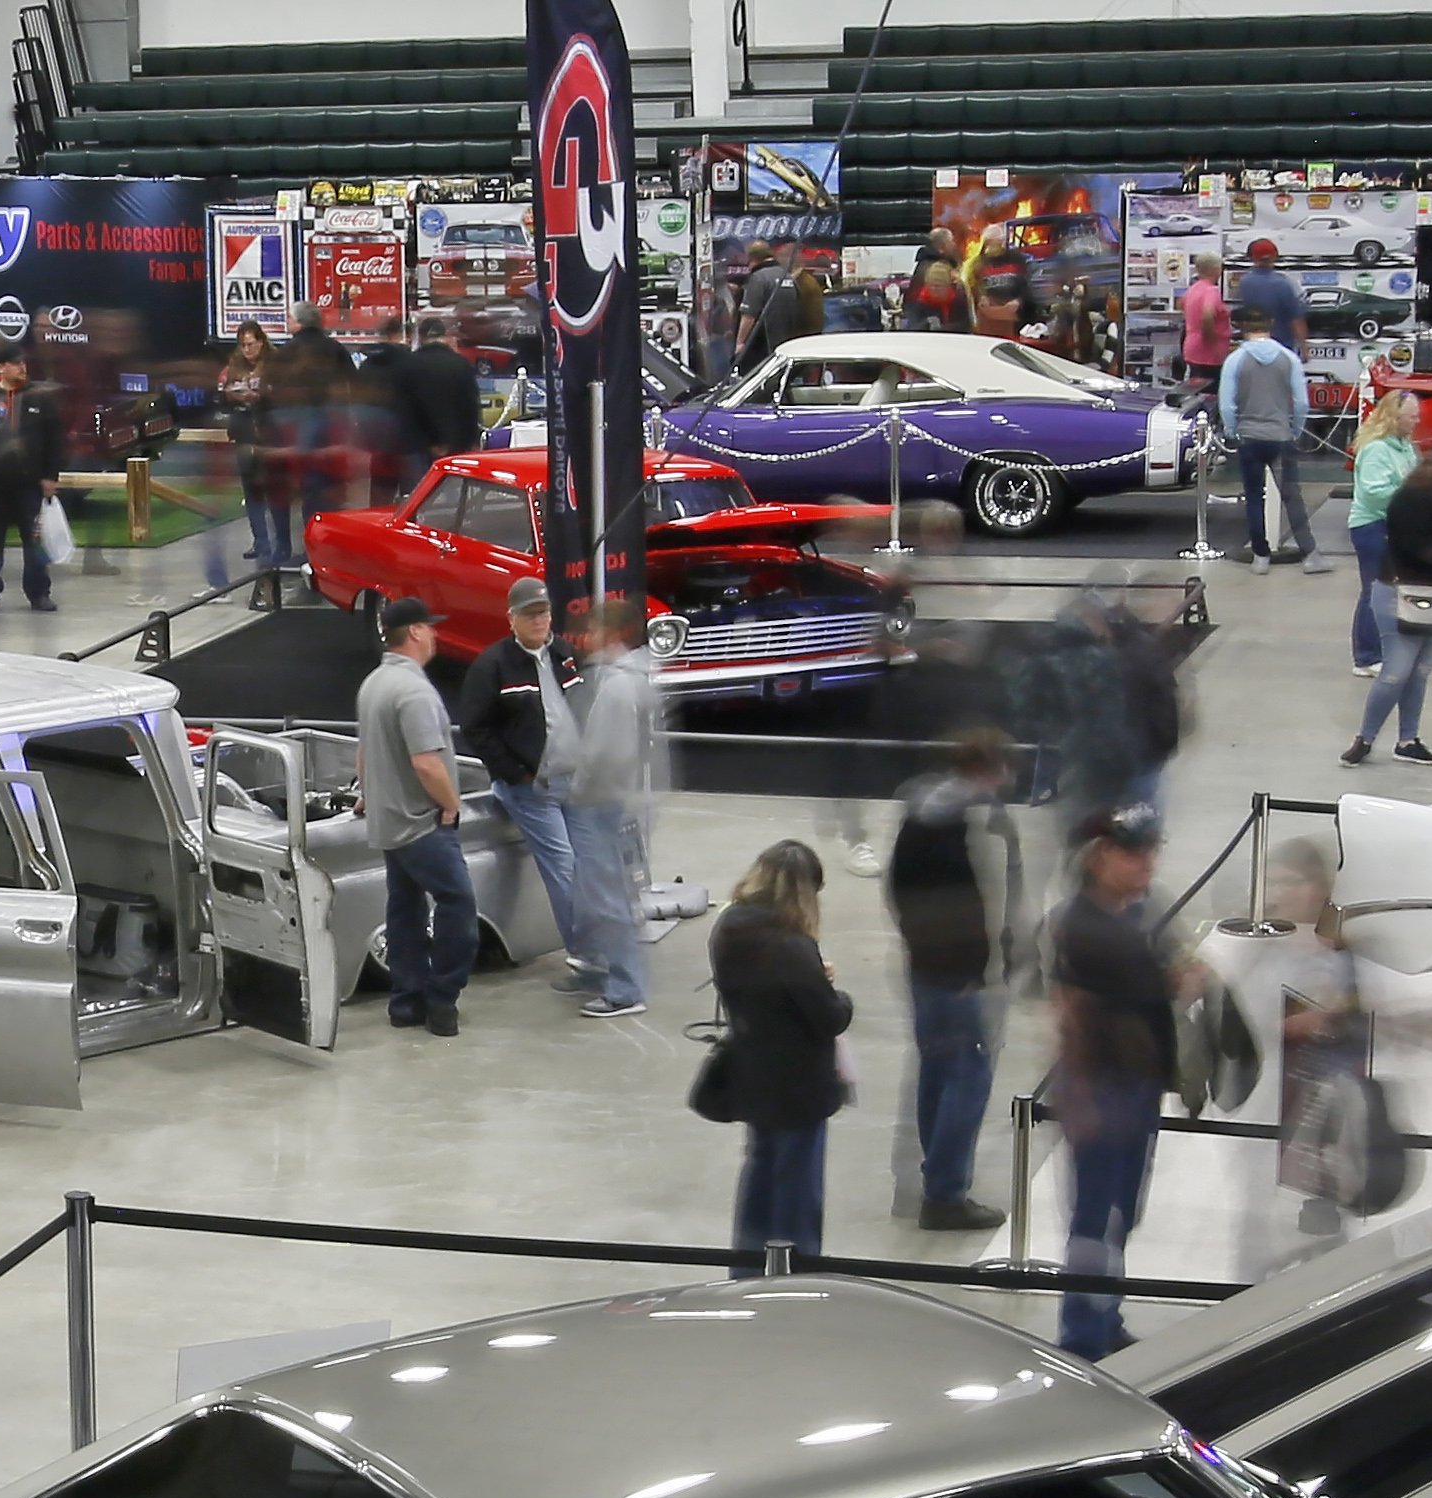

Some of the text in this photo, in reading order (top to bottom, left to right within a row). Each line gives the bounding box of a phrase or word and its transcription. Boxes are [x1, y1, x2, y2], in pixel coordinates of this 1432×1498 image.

[36, 220, 80, 251] Parts
[86, 223, 97, 251] &
[226, 225, 280, 235] AUTHORIZED
[148, 259, 191, 283] Fargo,
[335, 255, 395, 278] Coca-Cola
[226, 280, 285, 302] AMC
[44, 332, 90, 344] HYUNDAI
